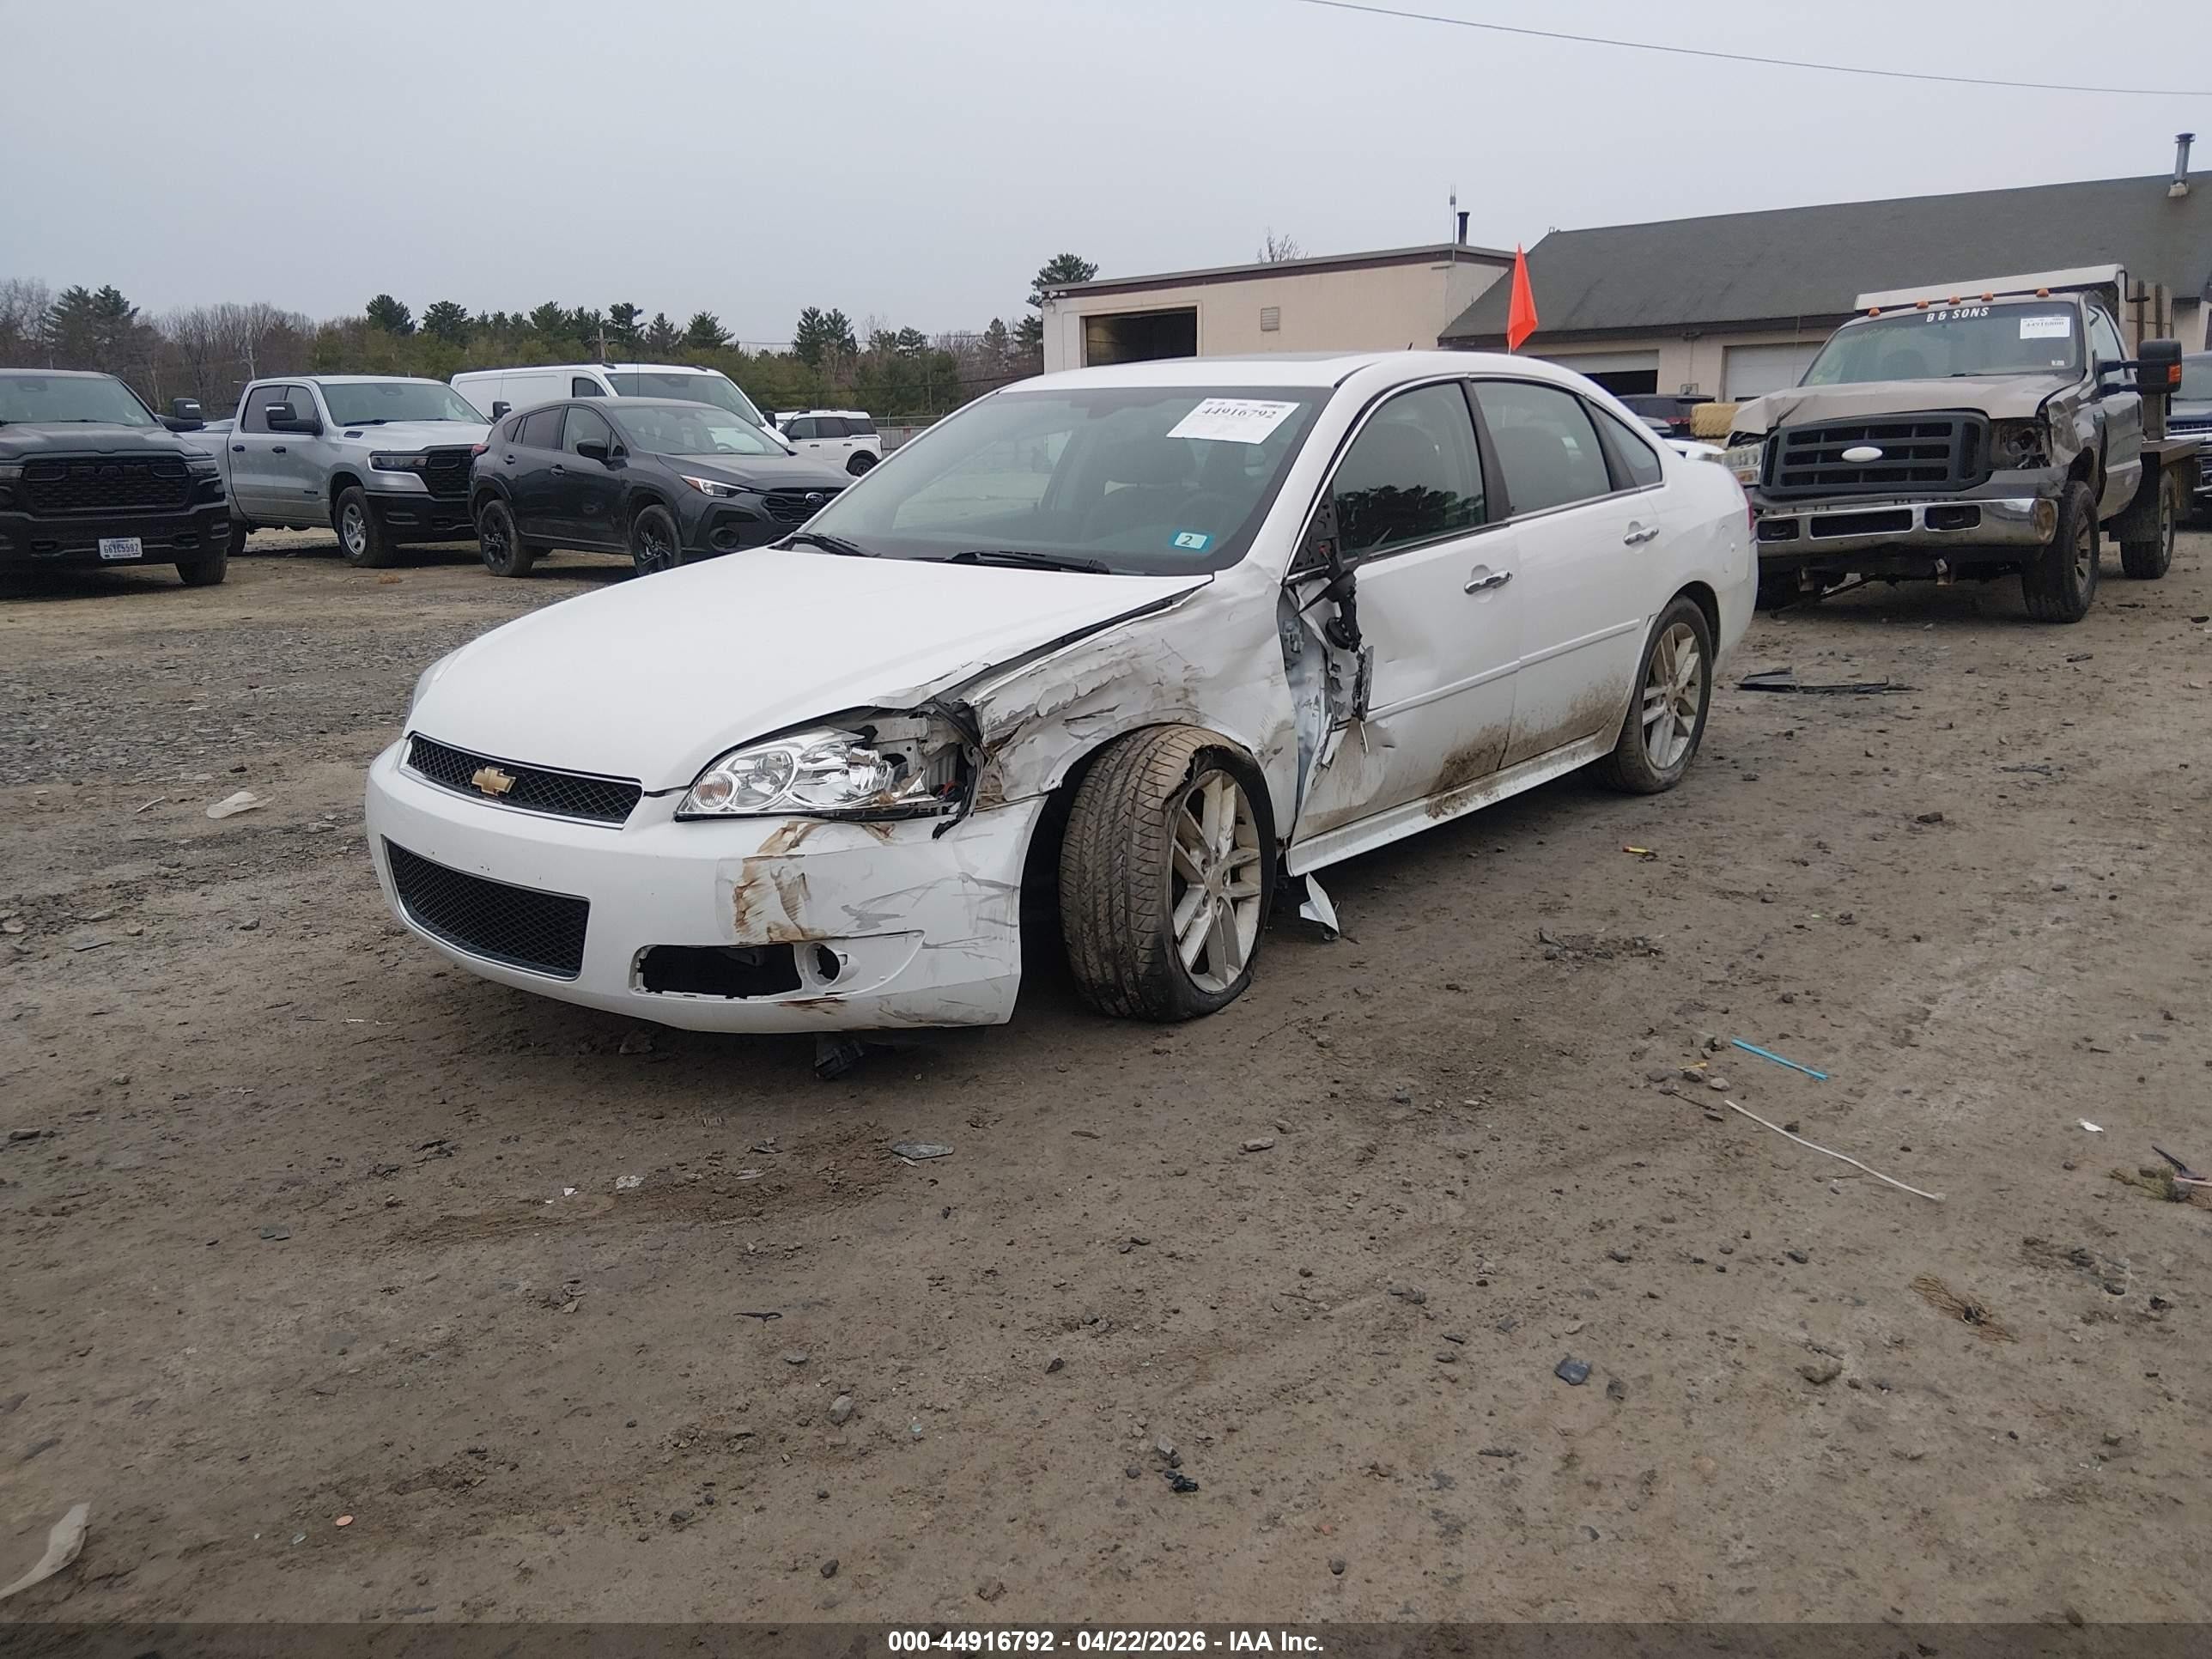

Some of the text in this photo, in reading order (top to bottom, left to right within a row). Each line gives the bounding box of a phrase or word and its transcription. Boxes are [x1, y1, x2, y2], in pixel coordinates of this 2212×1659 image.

[1952, 307, 1990, 319] SONS
[1202, 407, 1278, 419] 44916792
[1181, 535, 1193, 545] 2
